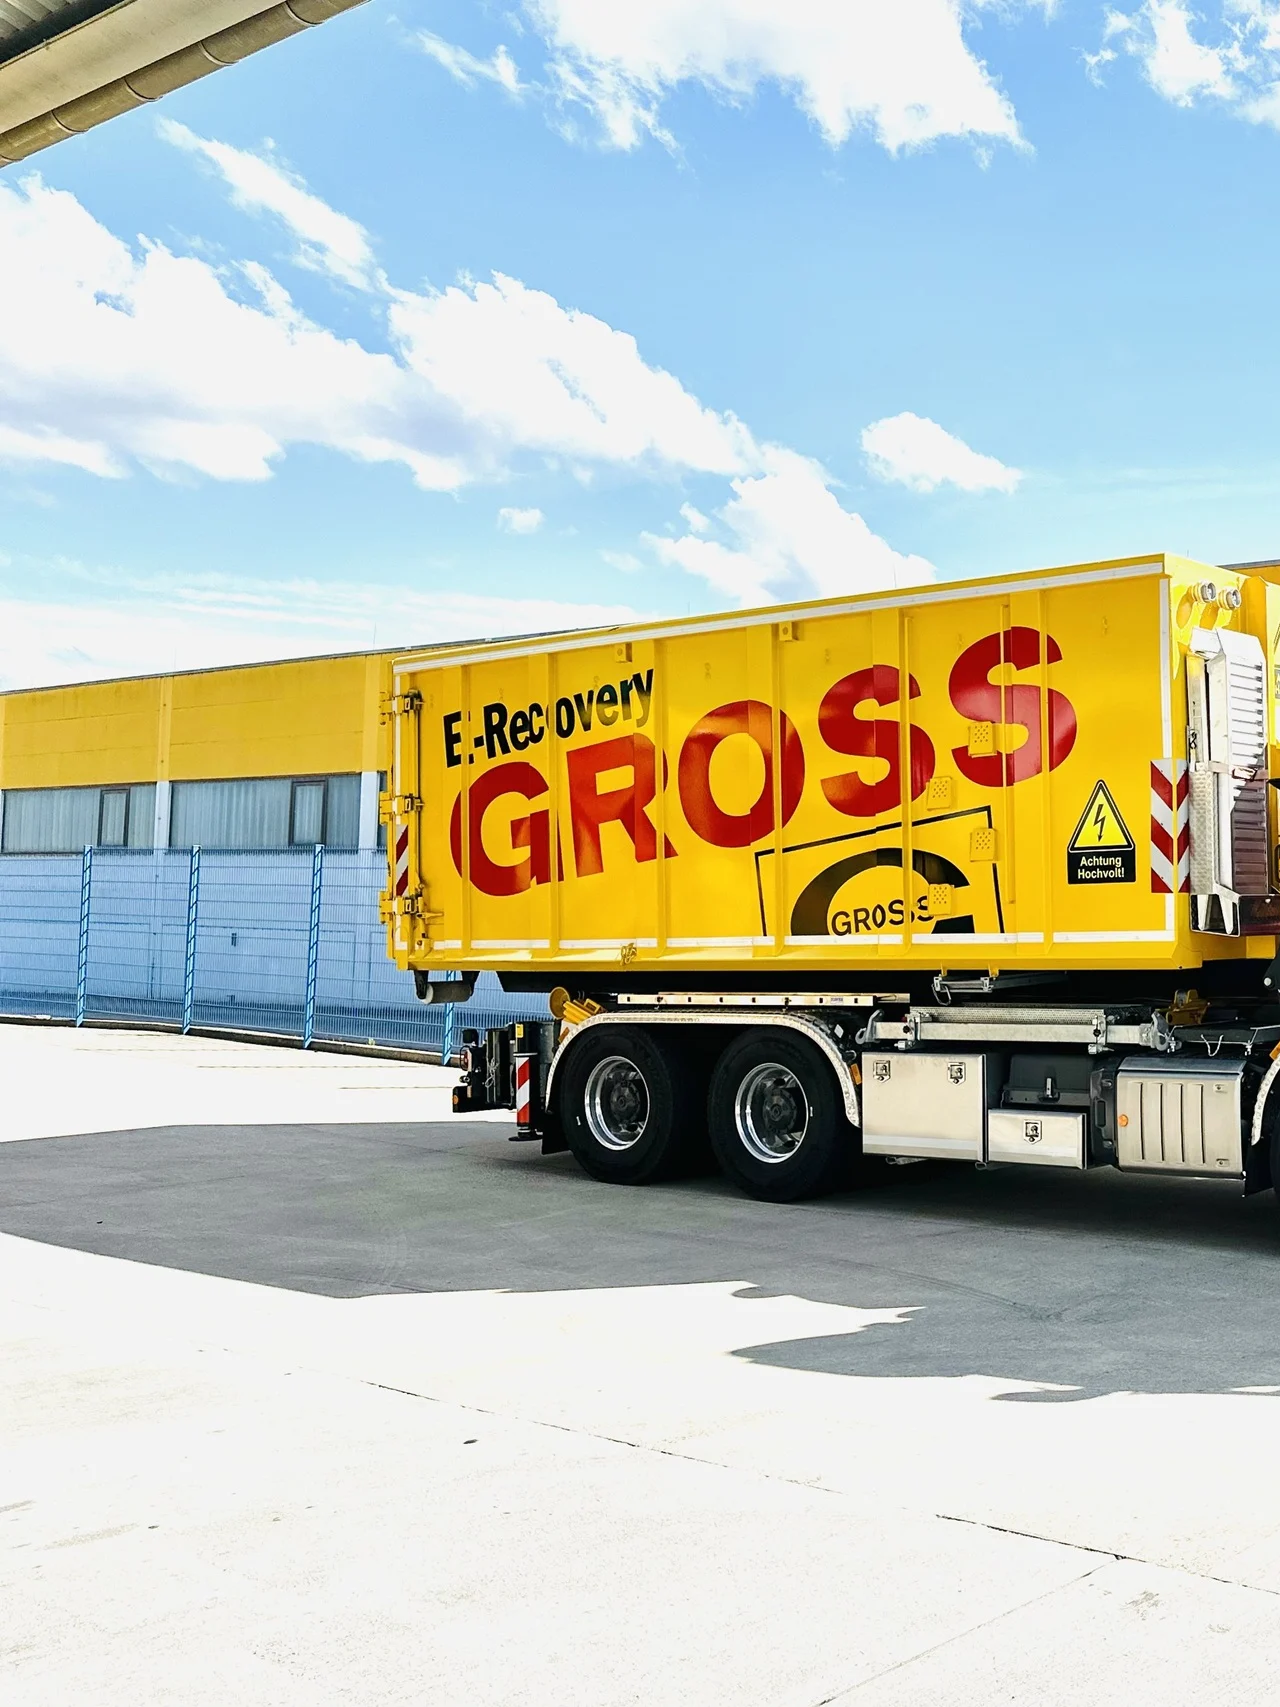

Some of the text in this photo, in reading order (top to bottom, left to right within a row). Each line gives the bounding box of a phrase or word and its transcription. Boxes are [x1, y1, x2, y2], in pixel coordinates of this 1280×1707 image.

[443, 668, 654, 769] E-Recovery
[449, 626, 1078, 897] GROSS
[1077, 867, 1125, 879] Hochvolt!
[1080, 855, 1122, 868] Achtung
[831, 895, 935, 936] GROSS
